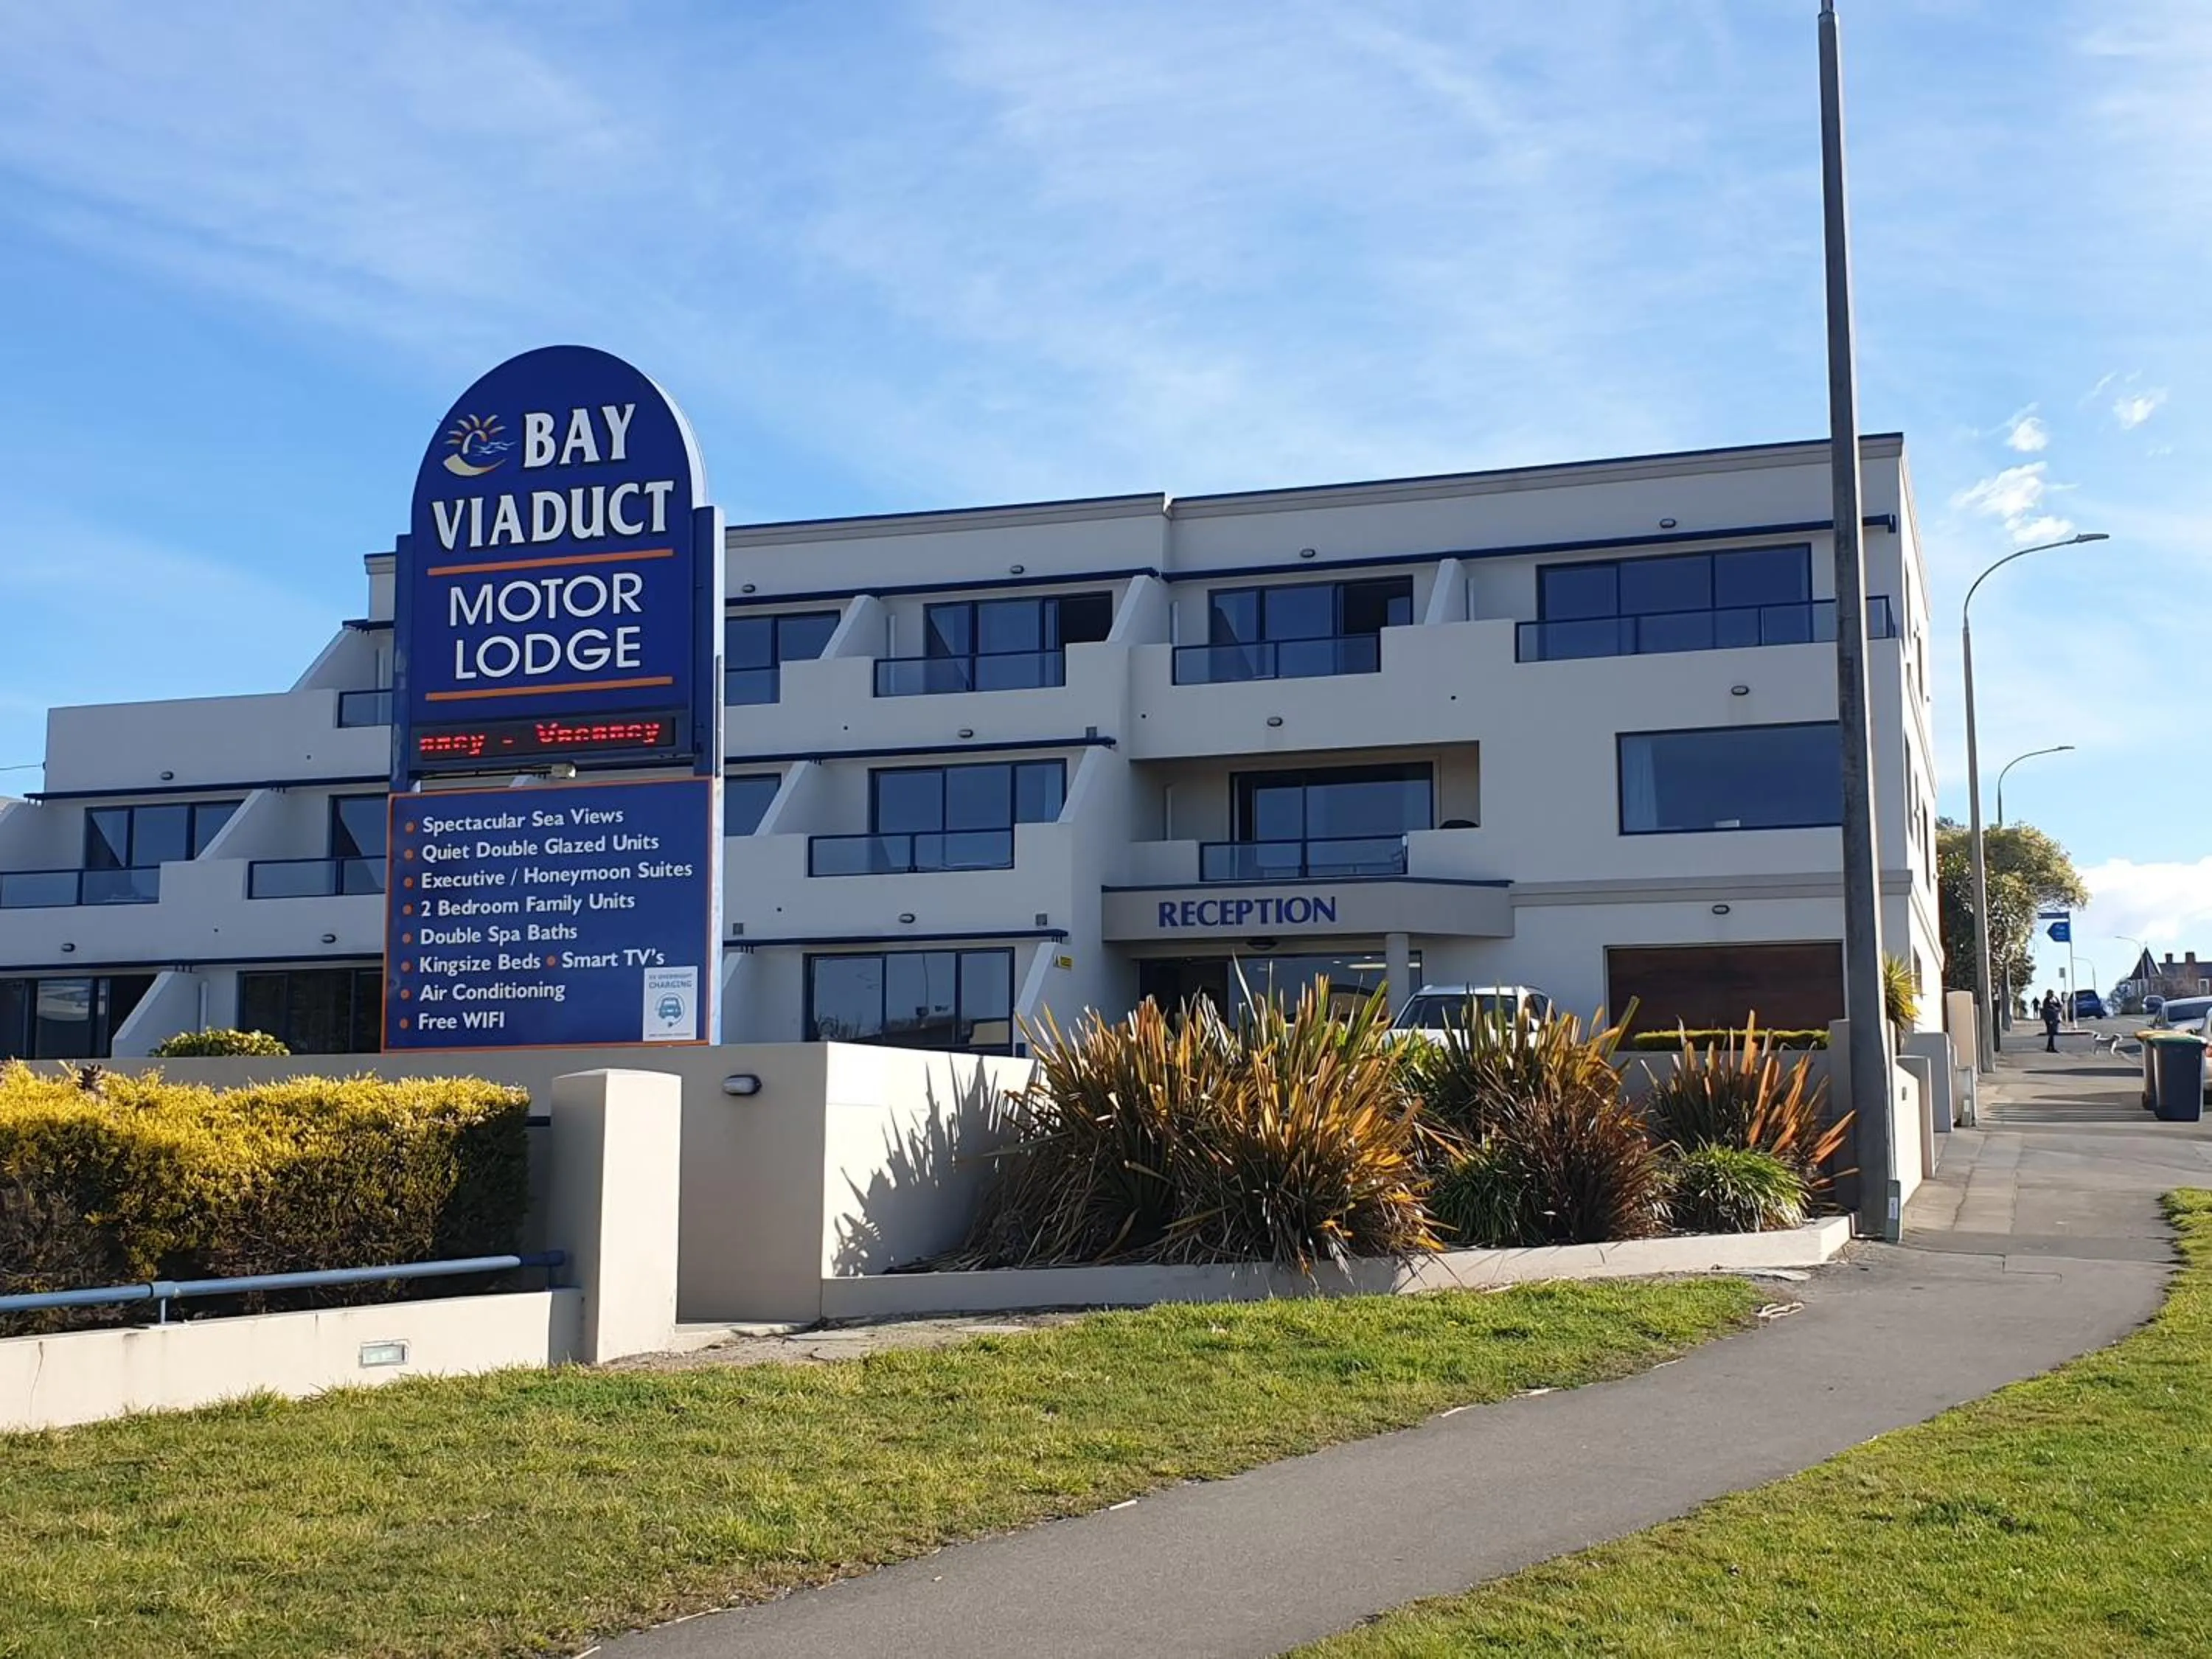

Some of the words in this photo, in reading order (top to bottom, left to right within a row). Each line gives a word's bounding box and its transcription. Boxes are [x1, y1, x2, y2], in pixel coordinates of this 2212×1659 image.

[524, 403, 636, 468] BAY
[432, 480, 674, 549] VIADUCT
[450, 573, 642, 626] MOTOR
[456, 626, 641, 679] LODGE
[535, 722, 661, 744] Vacancy
[422, 813, 526, 835] Spectacular
[532, 810, 565, 827] Sea
[570, 807, 624, 824] Views
[422, 843, 470, 862] Quiet
[476, 839, 538, 858] Double
[544, 835, 605, 855] Glazed
[613, 834, 659, 851] Units
[422, 872, 505, 888] Executive
[510, 869, 518, 886] /
[524, 867, 630, 886] Honeymoon
[638, 860, 692, 878] Suites
[421, 900, 431, 917] 2
[438, 899, 519, 917] Bedroom
[526, 894, 582, 915] Family
[589, 892, 635, 909] Units
[1158, 896, 1337, 928] RECEPTION
[420, 927, 481, 945] Double
[488, 925, 521, 947] Spa
[527, 922, 577, 941] Baths
[420, 955, 491, 977] Kingsize
[498, 953, 540, 970] Beds
[562, 951, 619, 968] Smart
[623, 948, 664, 966] TV's
[420, 984, 448, 1001] Air
[452, 981, 566, 1002] Conditioning
[418, 1012, 457, 1030] Free
[462, 1011, 504, 1029] WIFI
